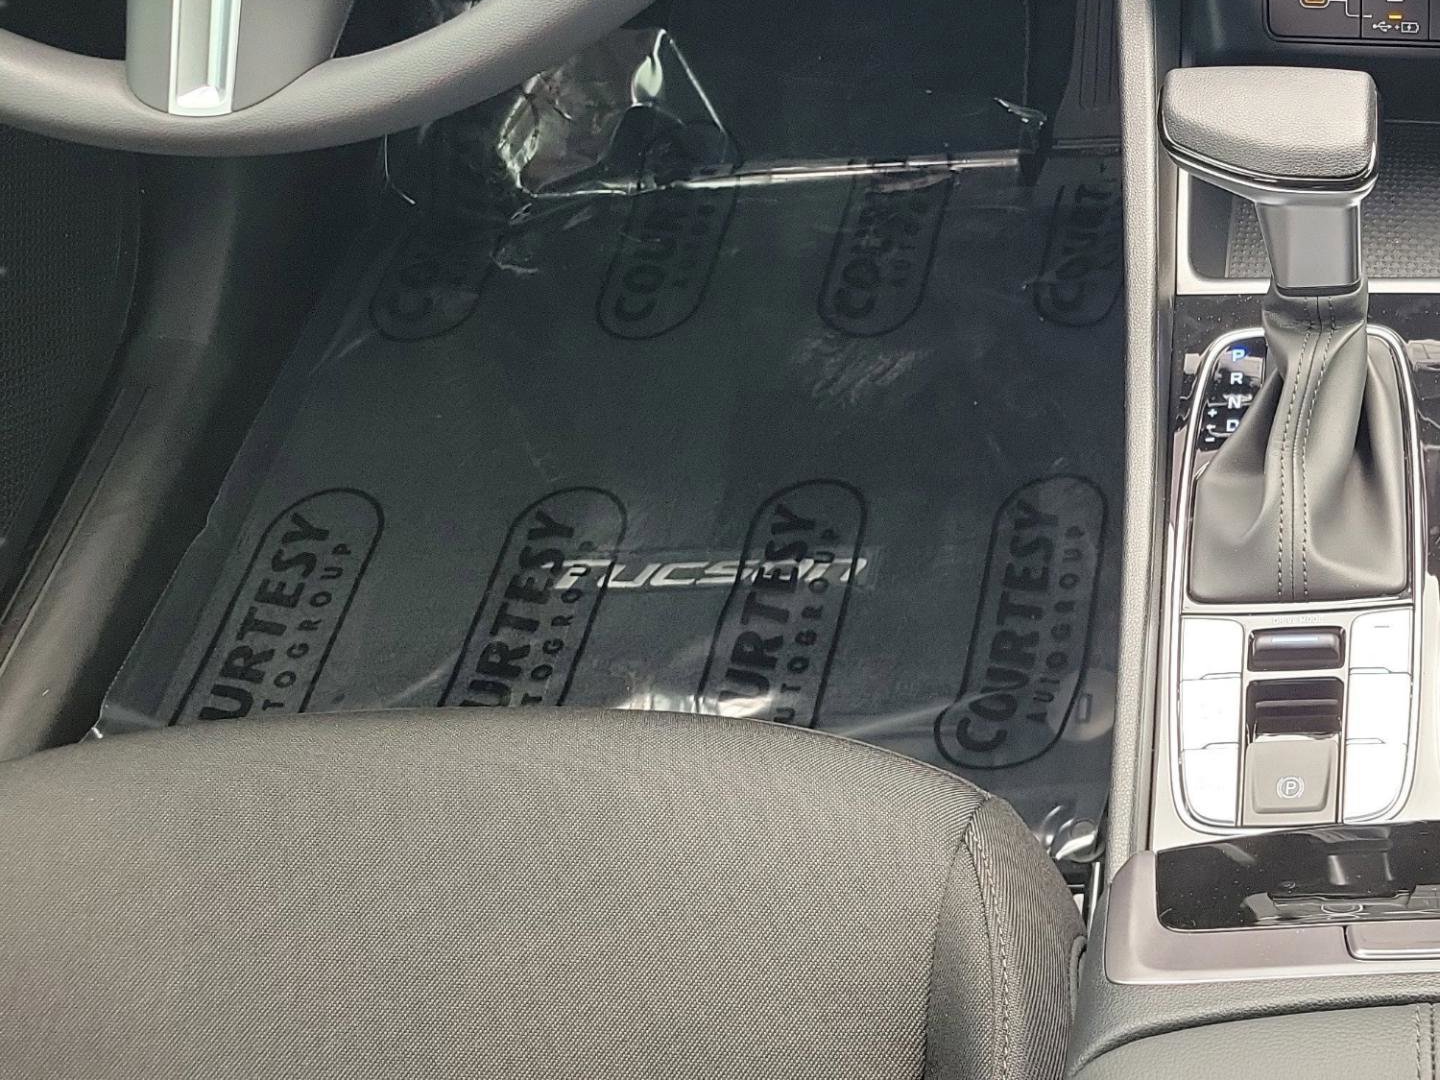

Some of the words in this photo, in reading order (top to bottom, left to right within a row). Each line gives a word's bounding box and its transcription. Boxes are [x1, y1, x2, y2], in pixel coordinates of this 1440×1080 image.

[1231, 348, 1246, 362] P
[1229, 372, 1243, 385] R
[1228, 397, 1242, 409] N
[1226, 420, 1240, 433] D
[201, 512, 331, 720] URTESY
